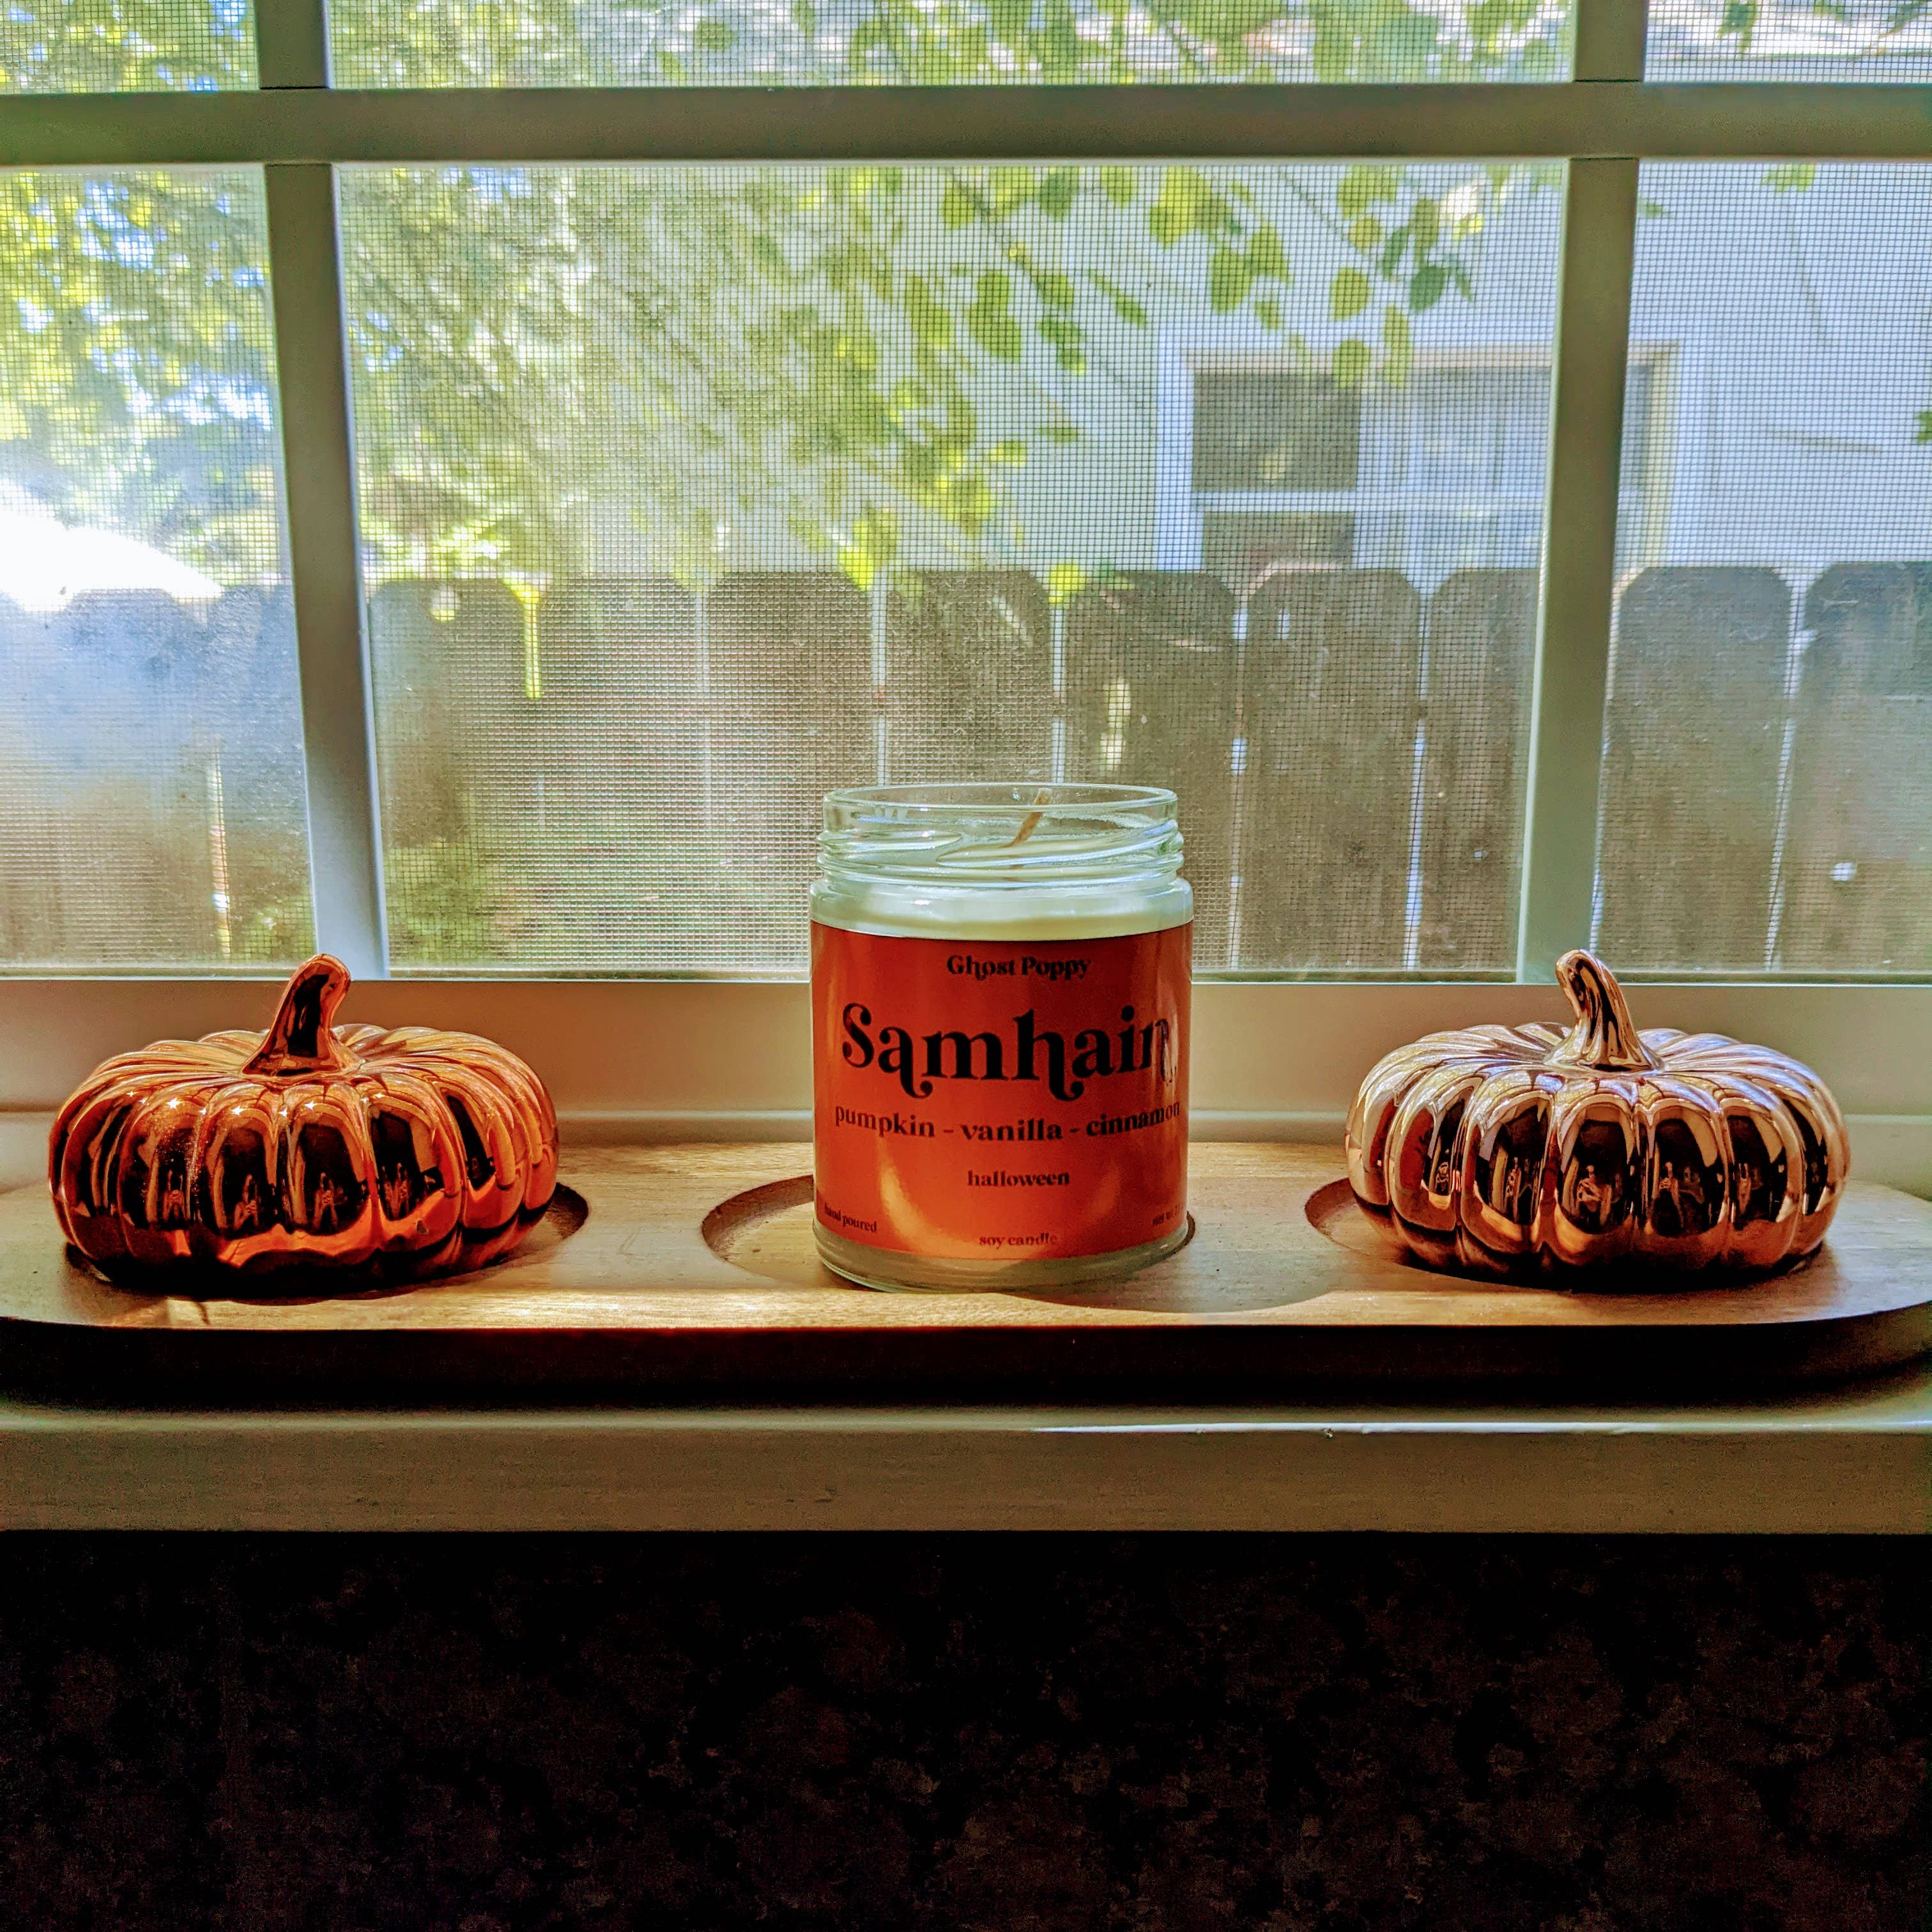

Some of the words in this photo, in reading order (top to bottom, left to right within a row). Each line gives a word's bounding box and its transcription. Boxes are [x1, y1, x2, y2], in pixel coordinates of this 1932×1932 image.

[947, 954, 1016, 981] Ghost
[1022, 956, 1091, 981] Poppy
[842, 1003, 1177, 1101] Samhain
[835, 1106, 936, 1138] pumpkin
[961, 1118, 1062, 1141] vanilla
[1087, 1101, 1181, 1137] cinnamon
[968, 1170, 1070, 1186] halloween
[842, 1215, 877, 1232] poured
[979, 1235, 1005, 1250] soy
[1008, 1232, 1058, 1246] candle
